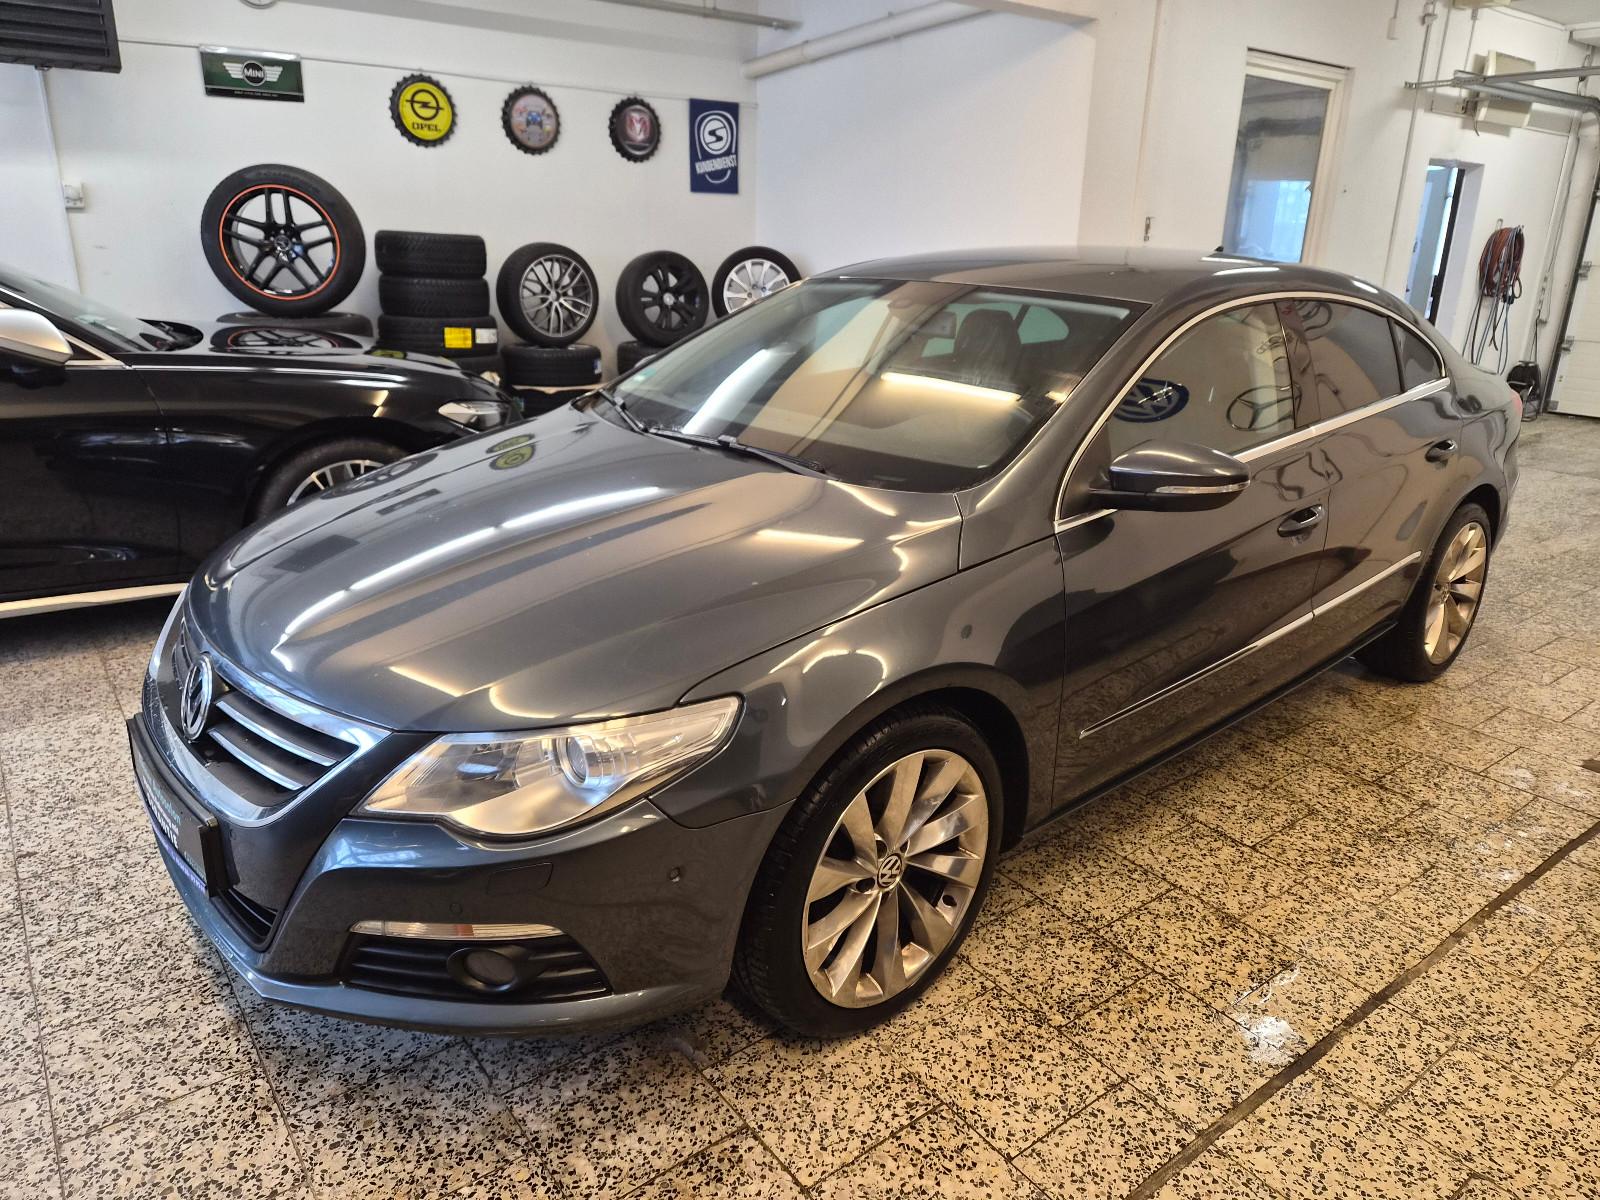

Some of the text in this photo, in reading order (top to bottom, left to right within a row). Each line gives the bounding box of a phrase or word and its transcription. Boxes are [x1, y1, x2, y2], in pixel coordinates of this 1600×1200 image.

[243, 67, 264, 78] MINI
[412, 121, 441, 132] OPEL
[695, 155, 737, 174] KUNDENDIENST
